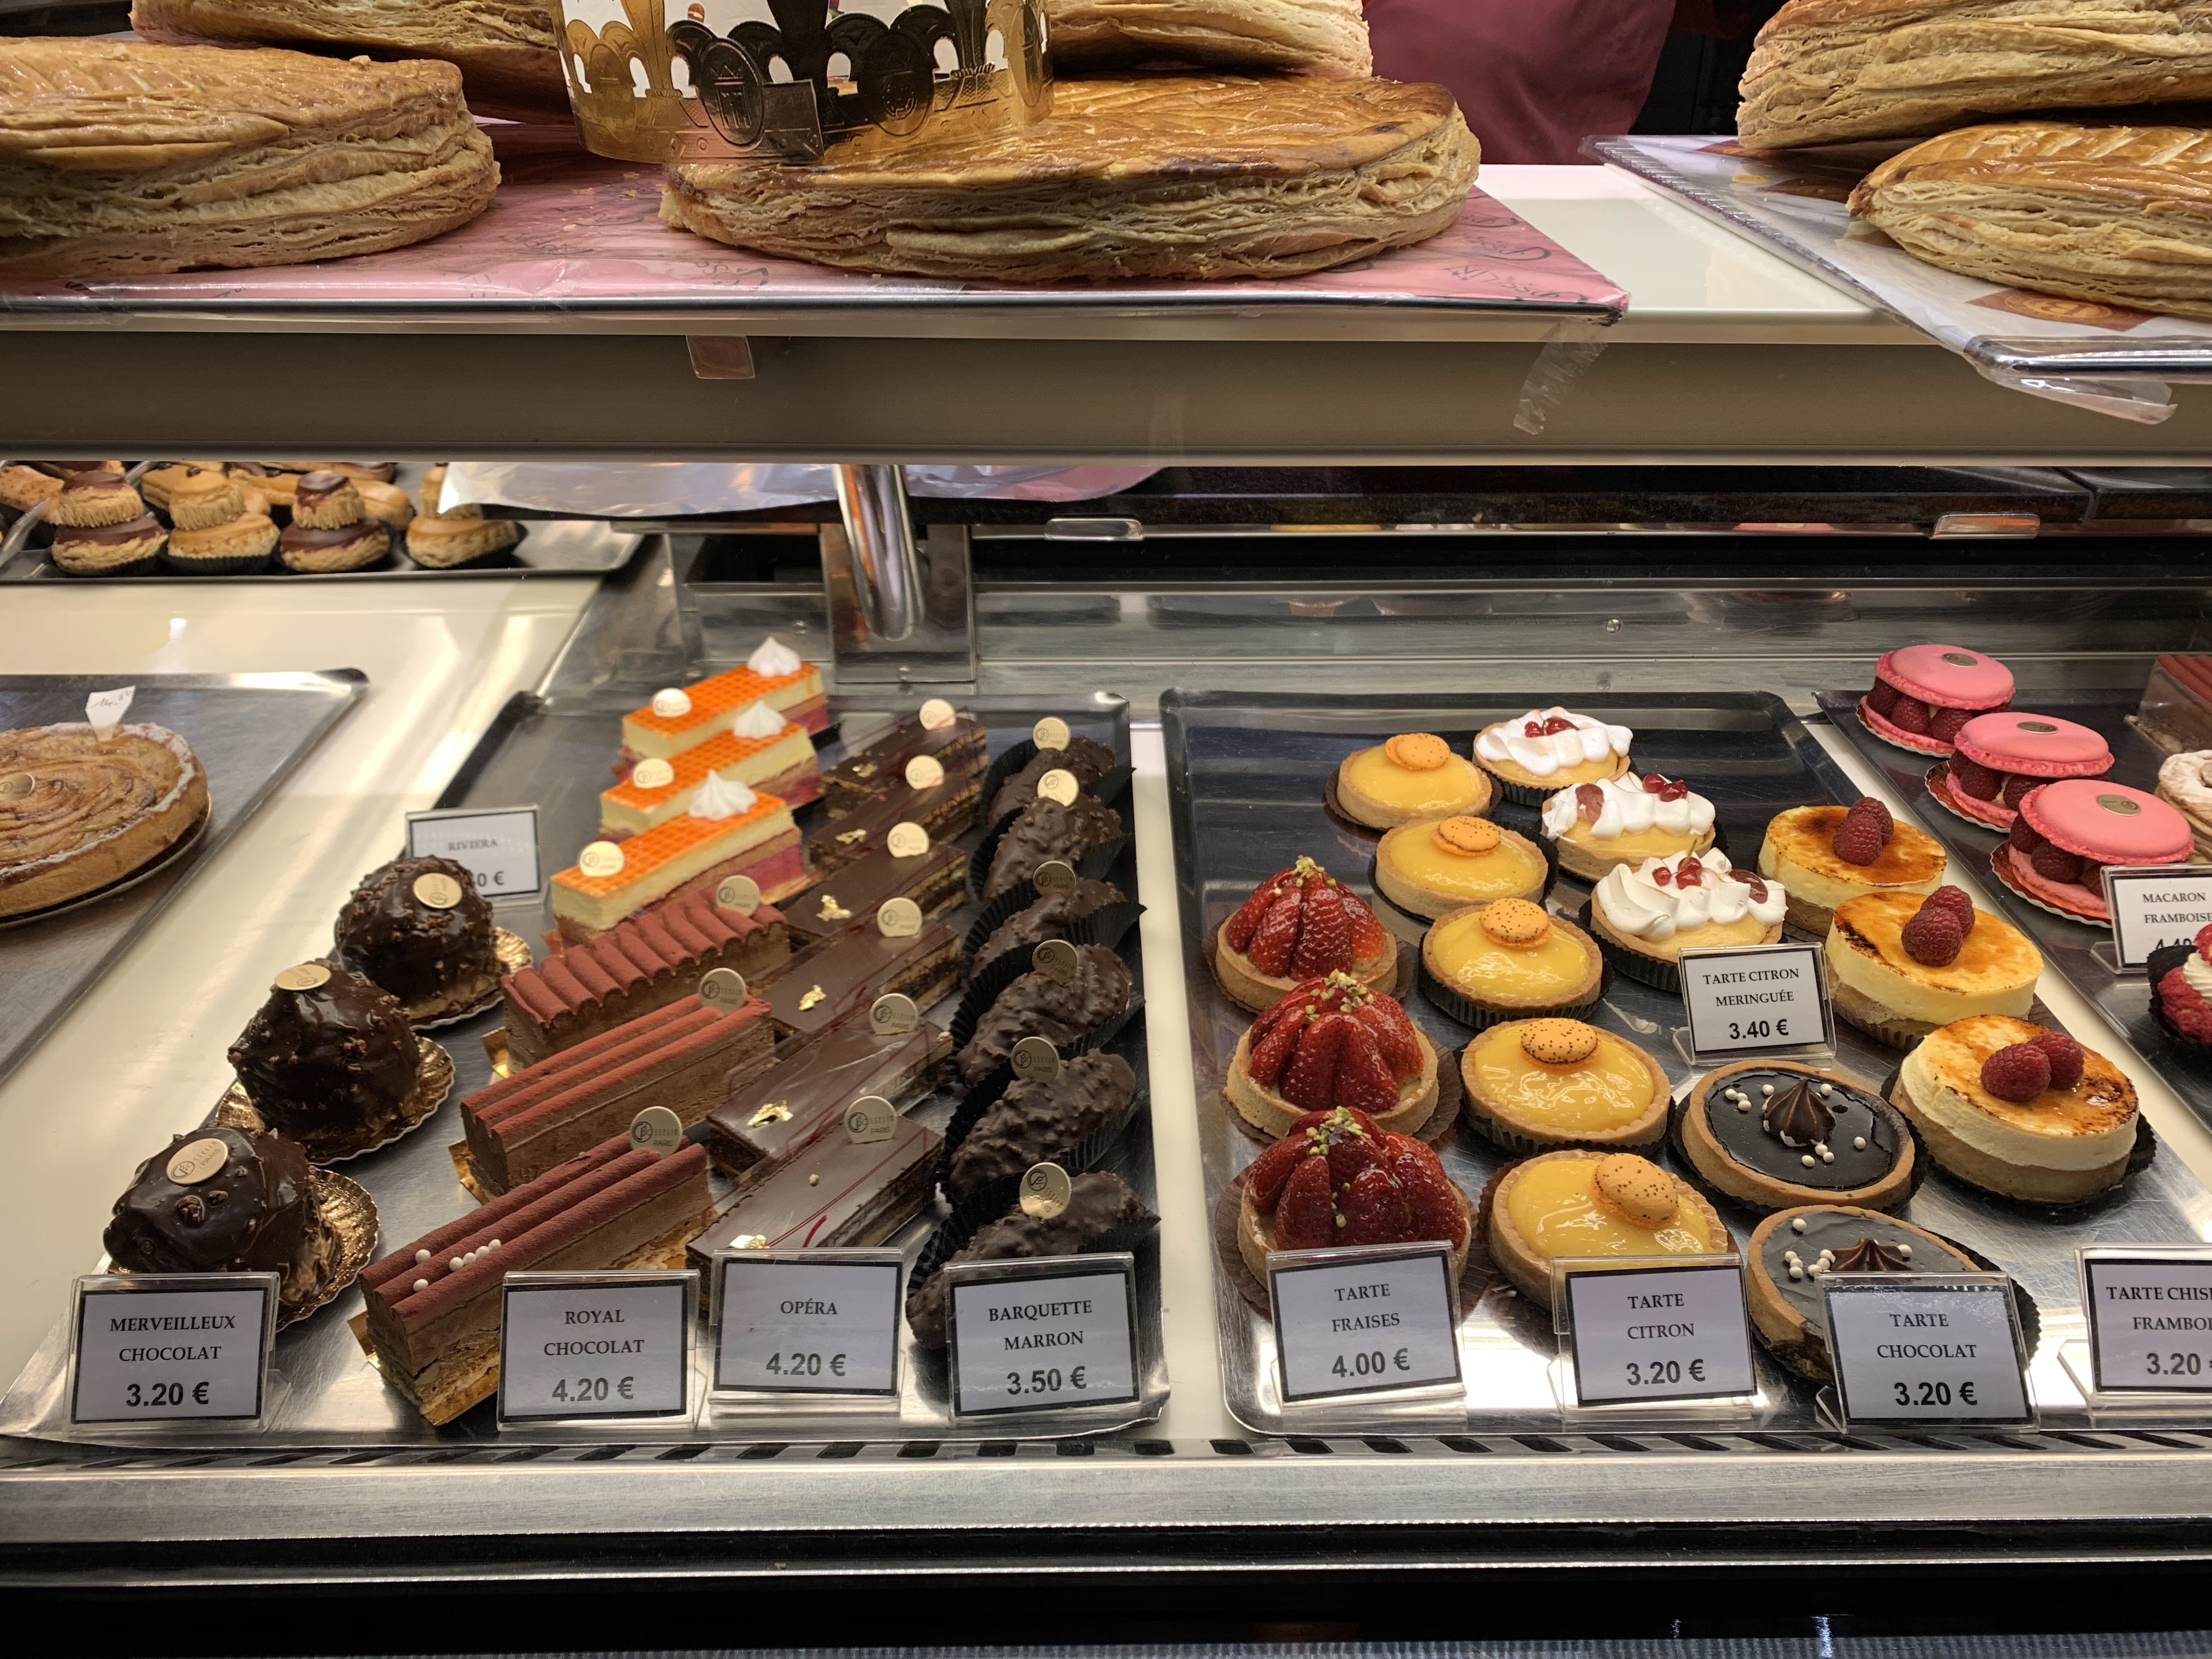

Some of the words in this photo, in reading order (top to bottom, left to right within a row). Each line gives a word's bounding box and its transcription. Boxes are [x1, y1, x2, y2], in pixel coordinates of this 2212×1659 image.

[448, 839, 498, 851] RIVIERA
[2143, 893, 2205, 902] MACARON
[2145, 913, 2212, 923] FRAMBOISE
[1703, 973, 1746, 984] TARTE
[1749, 969, 1798, 981] CITRON
[1716, 990, 1793, 1006] MERINGUÉE
[1729, 1020, 1770, 1039] 3.40
[1776, 1019, 1788, 1035] €
[1334, 1284, 1390, 1301] TARTE
[2106, 1287, 2163, 1300] TARTE
[781, 1299, 838, 1314] OPÉRA
[1628, 1294, 1684, 1308] TARTE
[565, 1310, 624, 1324] ROYAL
[989, 1300, 1092, 1321] BARQUETTE
[110, 1316, 235, 1331] MERVEILLEUX
[1332, 1313, 1400, 1332] FRAISES
[1889, 1314, 1948, 1327] TARTE
[2133, 1317, 2212, 1330] FRAMBOI
[1628, 1323, 1694, 1339] CITRON
[544, 1340, 644, 1356] CHOCOLAT
[1005, 1331, 1083, 1350] MARRON
[120, 1346, 221, 1361] CHOCOLAT
[1877, 1345, 1976, 1358] CHOCOLAT
[766, 1353, 821, 1375] 4.20
[830, 1354, 846, 1376] €
[1332, 1351, 1385, 1377] 4.00
[1393, 1348, 1410, 1370] €
[2147, 1353, 2200, 1375] 3.20
[1627, 1361, 1680, 1385] 3.20
[1689, 1359, 1705, 1381] €
[1007, 1369, 1062, 1395] 3.50
[1070, 1366, 1086, 1389] €
[126, 1383, 183, 1407] 3.20
[192, 1382, 209, 1404] €
[552, 1378, 608, 1402] 4.20
[617, 1376, 634, 1399] €
[1894, 1383, 1951, 1406] 3.20
[1959, 1382, 1977, 1406] €
